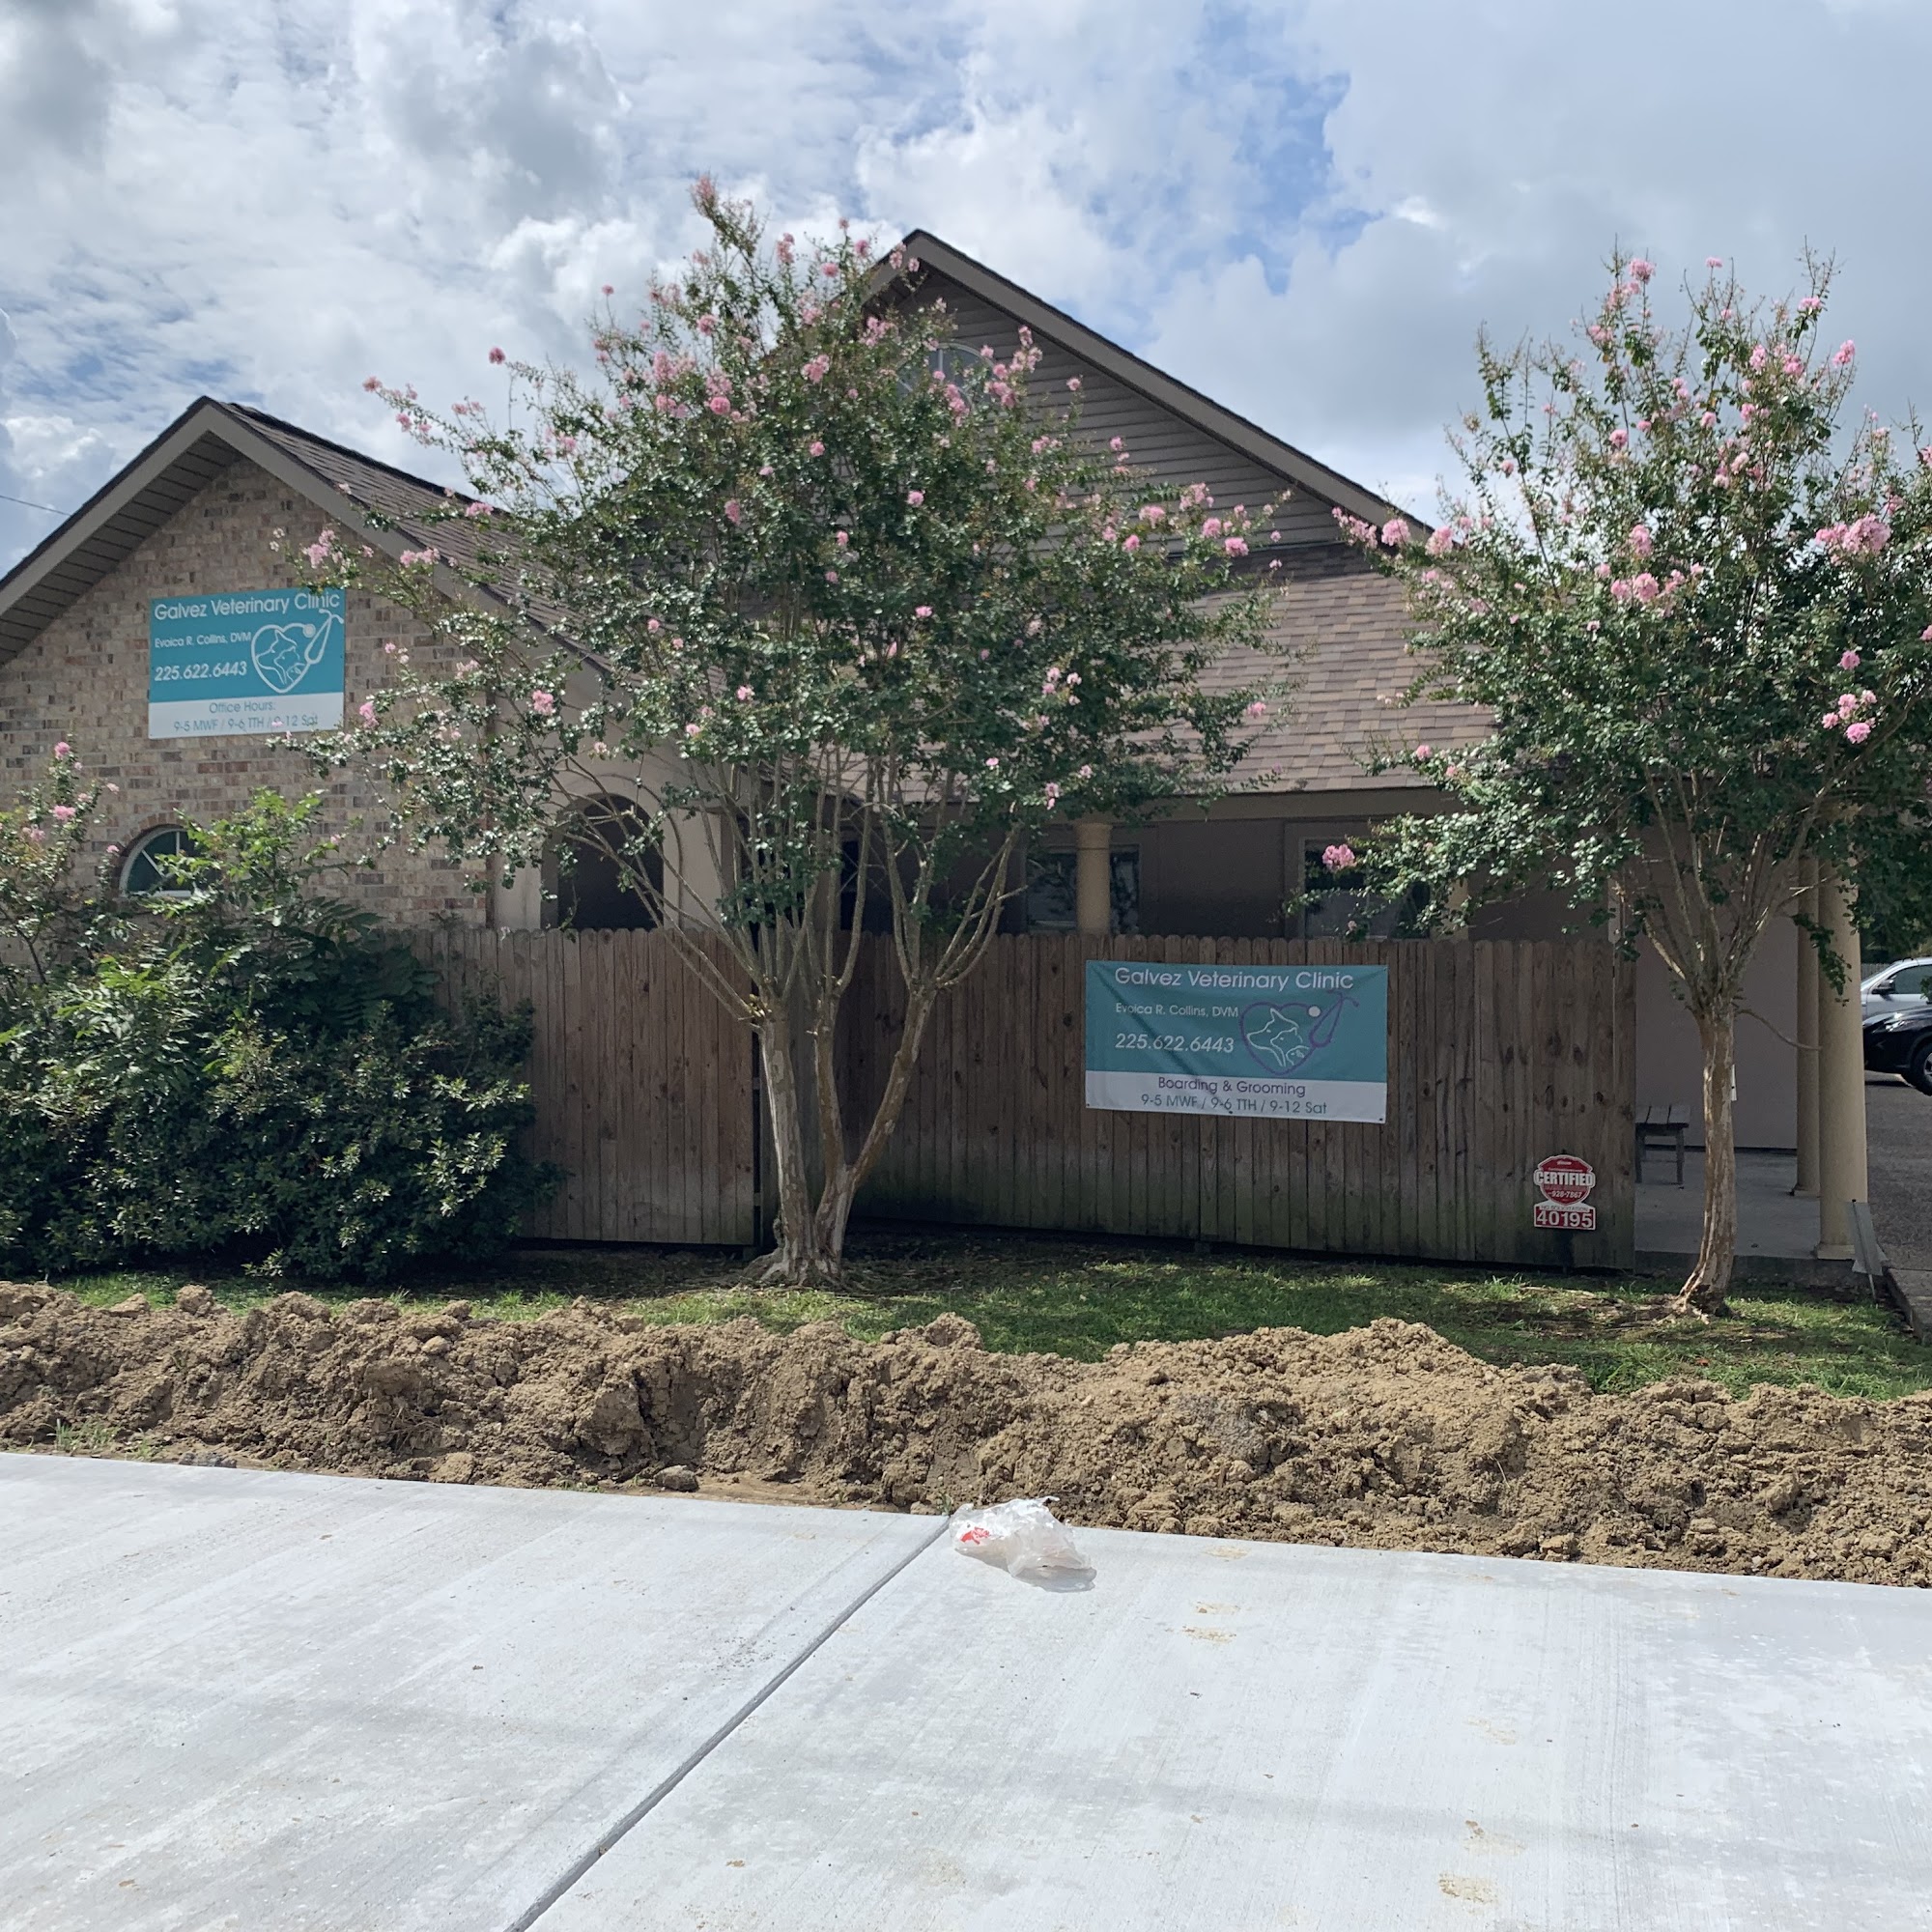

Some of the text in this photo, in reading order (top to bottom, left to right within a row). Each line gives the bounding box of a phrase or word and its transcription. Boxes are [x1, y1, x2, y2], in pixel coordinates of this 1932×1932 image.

[155, 592, 340, 620] Galvez Veterinary Clinic
[197, 634, 228, 644] Collins,
[230, 632, 251, 642] DVM
[155, 661, 247, 681] 225.622.6443
[210, 700, 275, 714] Office Hours:
[174, 721, 190, 731] 9-5
[193, 719, 218, 730] MWF
[228, 718, 245, 728] 9-6
[248, 717, 265, 727] TTH
[301, 714, 319, 726] Sat
[1115, 967, 1354, 992] Galvez Veterinary Clinic
[1156, 1004, 1166, 1015] R.
[1169, 1005, 1208, 1017] Collins,
[1211, 1006, 1238, 1017] DVM
[1115, 1033, 1235, 1054] 225.622.6443
[1158, 1076, 1306, 1098] Boarding & Grooming
[1141, 1094, 1163, 1106] 9-5
[1166, 1094, 1198, 1108] MWF
[1210, 1096, 1233, 1111] 9-6
[1236, 1098, 1258, 1111] TTH
[1270, 1099, 1300, 1113] 9-12
[1305, 1101, 1327, 1115] Sat
[1536, 1171, 1593, 1186] CERTIFIED
[1537, 1210, 1593, 1228] 40195
